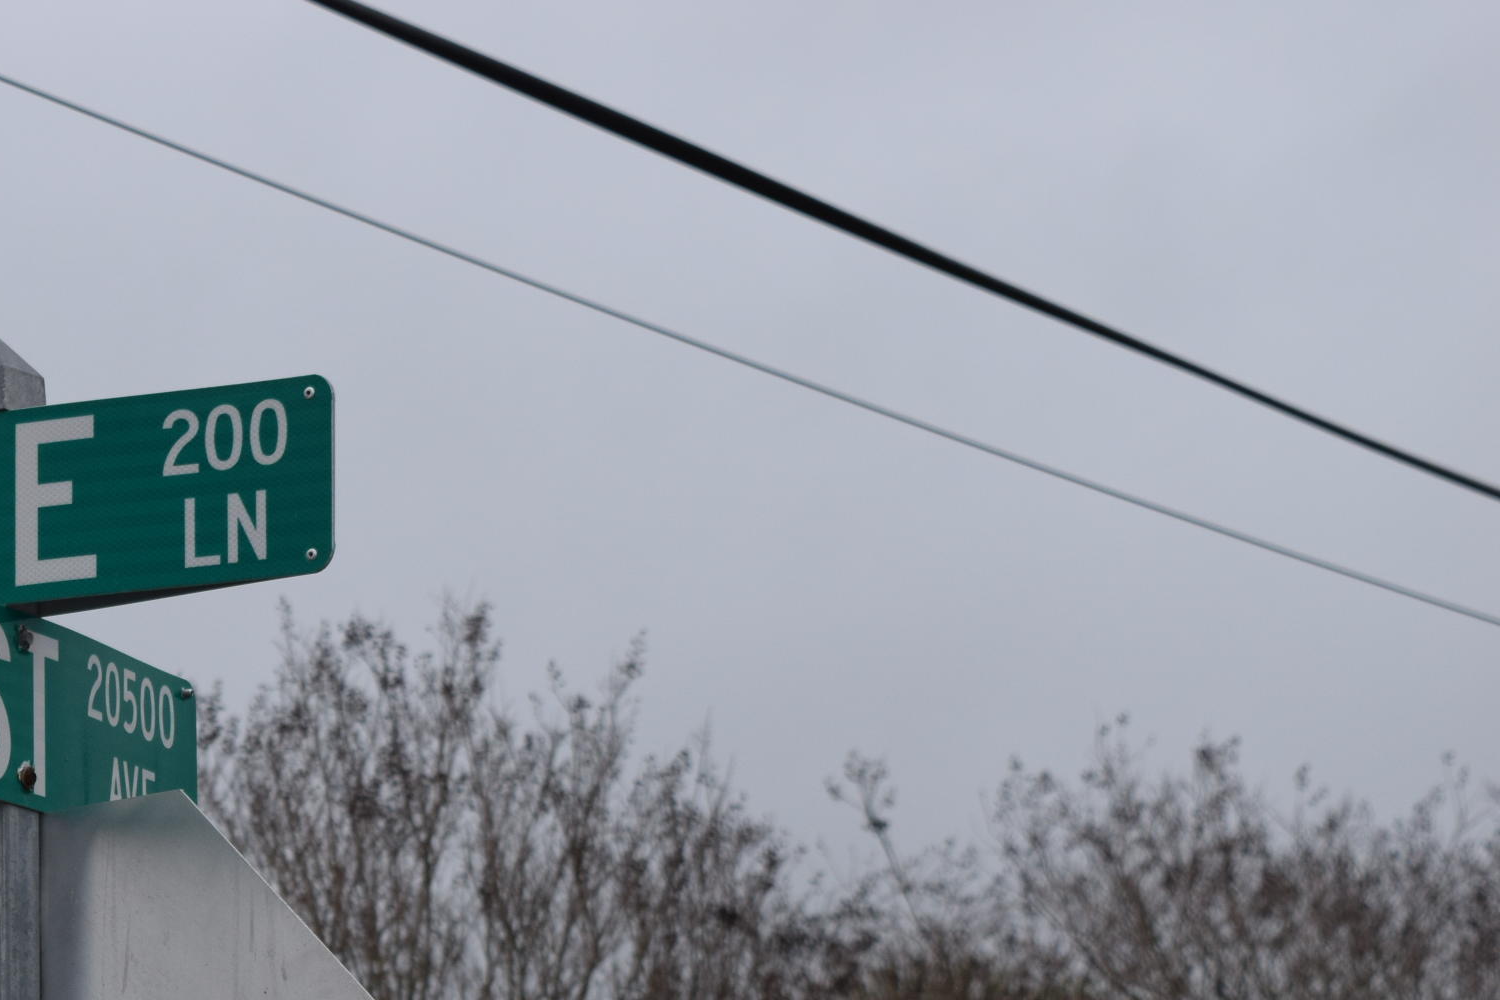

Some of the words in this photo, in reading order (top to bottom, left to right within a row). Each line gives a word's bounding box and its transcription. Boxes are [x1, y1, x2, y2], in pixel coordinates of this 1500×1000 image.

[162, 399, 287, 477] 200
[184, 489, 267, 568] LN
[87, 654, 175, 749] 20500
